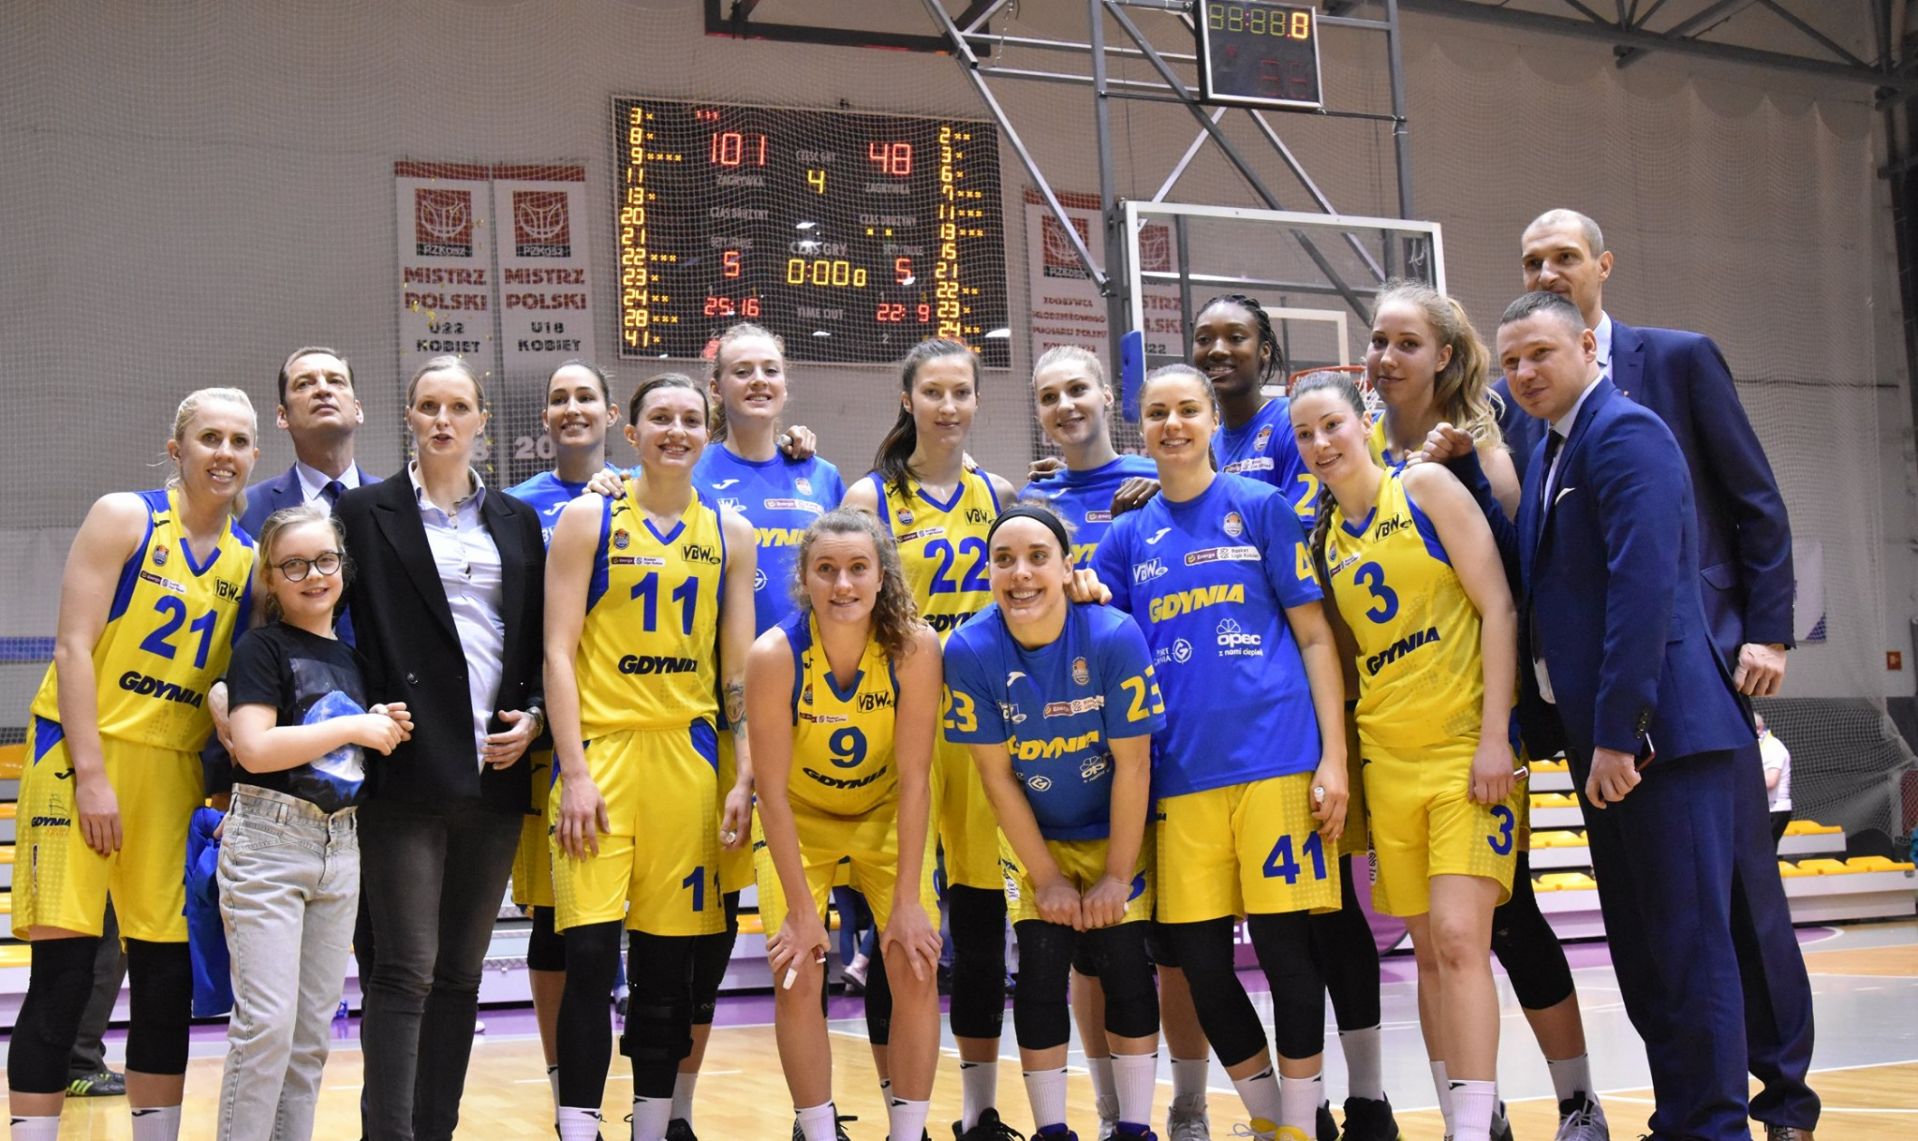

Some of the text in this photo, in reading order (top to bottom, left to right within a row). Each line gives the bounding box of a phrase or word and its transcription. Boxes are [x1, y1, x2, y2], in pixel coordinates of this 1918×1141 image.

[630, 107, 642, 125] 3
[629, 127, 642, 145] 8
[939, 126, 951, 144] 2
[630, 147, 643, 164] 9
[712, 132, 765, 166] 101
[941, 146, 952, 163] 3
[869, 142, 912, 175] 48
[627, 167, 643, 183] 11
[807, 169, 826, 194] 4
[941, 165, 953, 182] 6
[628, 187, 644, 205] 13
[942, 185, 954, 201] 7
[620, 207, 645, 225] 20
[939, 204, 955, 220] 11
[621, 227, 645, 245] 21
[940, 223, 956, 241] 13
[622, 247, 646, 266] 22
[822, 242, 848, 256] GRY
[941, 243, 957, 260] 15
[723, 250, 740, 277] 5
[895, 257, 912, 284] 5
[935, 261, 958, 279] 21
[404, 266, 487, 286] MISTRZ
[504, 267, 586, 285] MISTRZ
[623, 267, 647, 286] 23
[623, 288, 648, 306] 24
[936, 281, 959, 299] 22
[405, 292, 488, 311] POLSKI
[506, 292, 587, 310] POLSKI
[937, 301, 960, 318] 23
[624, 308, 648, 327] 28
[797, 307, 844, 320] TIME OUT
[429, 321, 465, 334] U22
[531, 321, 564, 334] U18
[938, 320, 961, 337] 24
[416, 339, 480, 353] KOBIET
[518, 338, 581, 352] KOBIET
[625, 330, 649, 347] 41
[682, 544, 712, 563] VBW
[923, 536, 991, 597] 22
[1353, 560, 1400, 625] 3
[630, 571, 699, 636] 11
[1148, 583, 1245, 624] GDYNIA
[139, 595, 219, 671] 21
[1217, 632, 1262, 648] opec
[1366, 625, 1441, 677] GDYNIA
[617, 654, 698, 675] GDYNIA
[118, 670, 204, 709] GDYNIA
[858, 690, 889, 711] VBW
[828, 725, 868, 769] 9
[802, 764, 888, 790] GDYNIA
[1486, 804, 1515, 857] 3
[1262, 829, 1328, 885] 41
